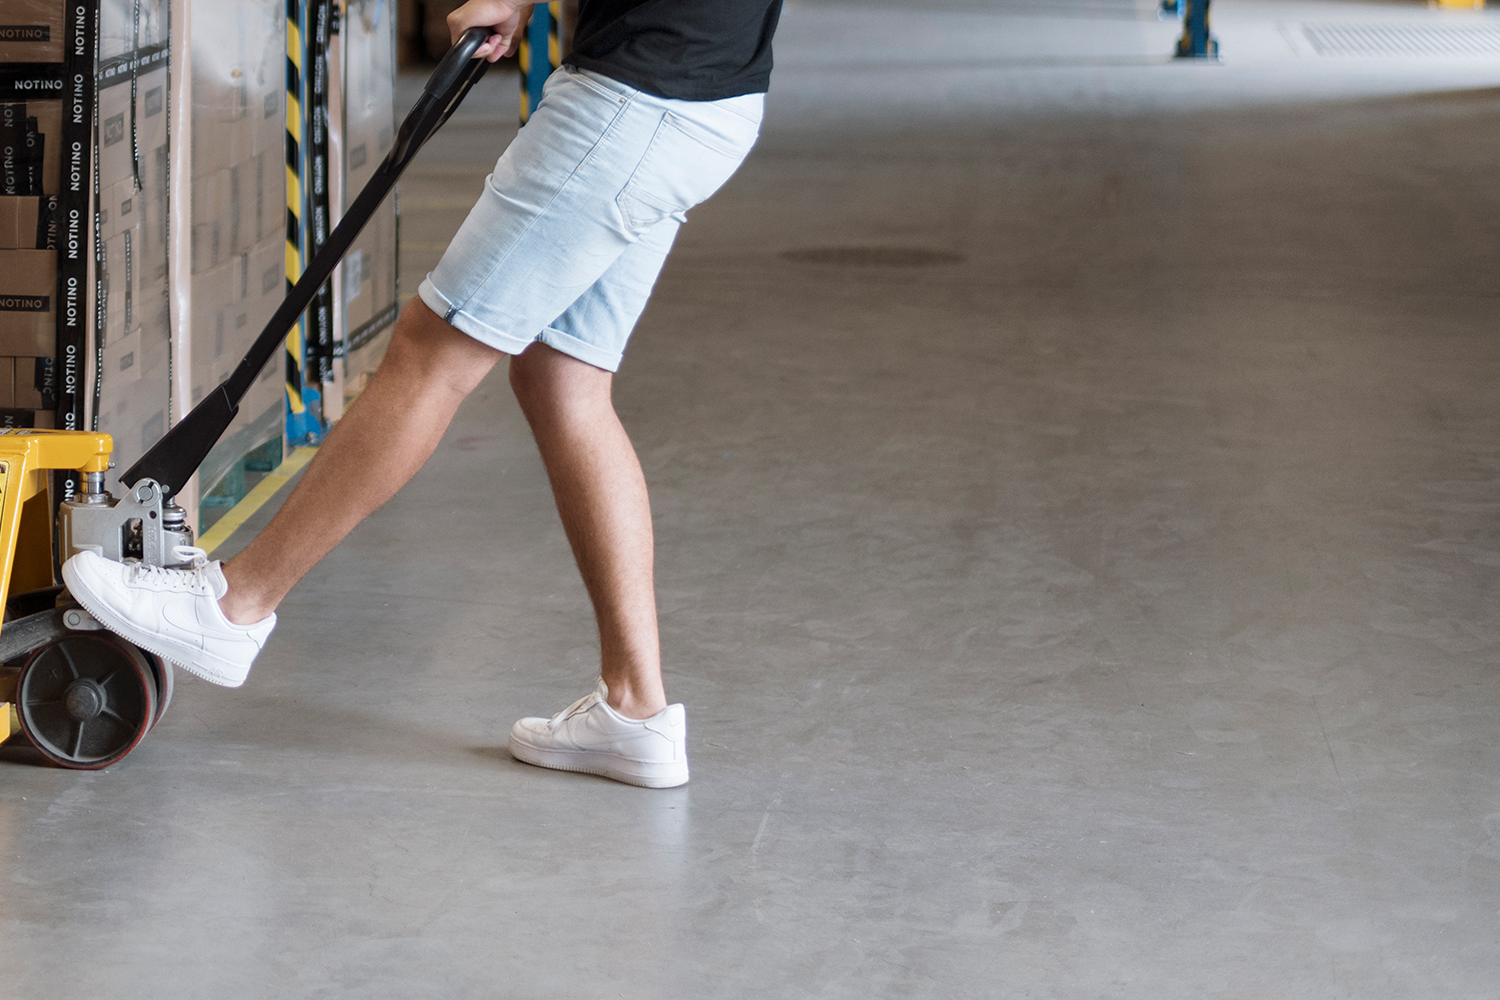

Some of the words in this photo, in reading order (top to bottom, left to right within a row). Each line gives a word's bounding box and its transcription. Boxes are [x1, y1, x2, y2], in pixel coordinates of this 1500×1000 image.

[75, 6, 85, 56] NOTINO
[14, 80, 63, 90] NOTINO
[73, 74, 83, 124] NOTINO
[70, 141, 81, 191] NOTINO
[68, 210, 79, 259] NOTINO
[67, 277, 77, 327] NOTINO
[65, 344, 76, 394] NOTINO
